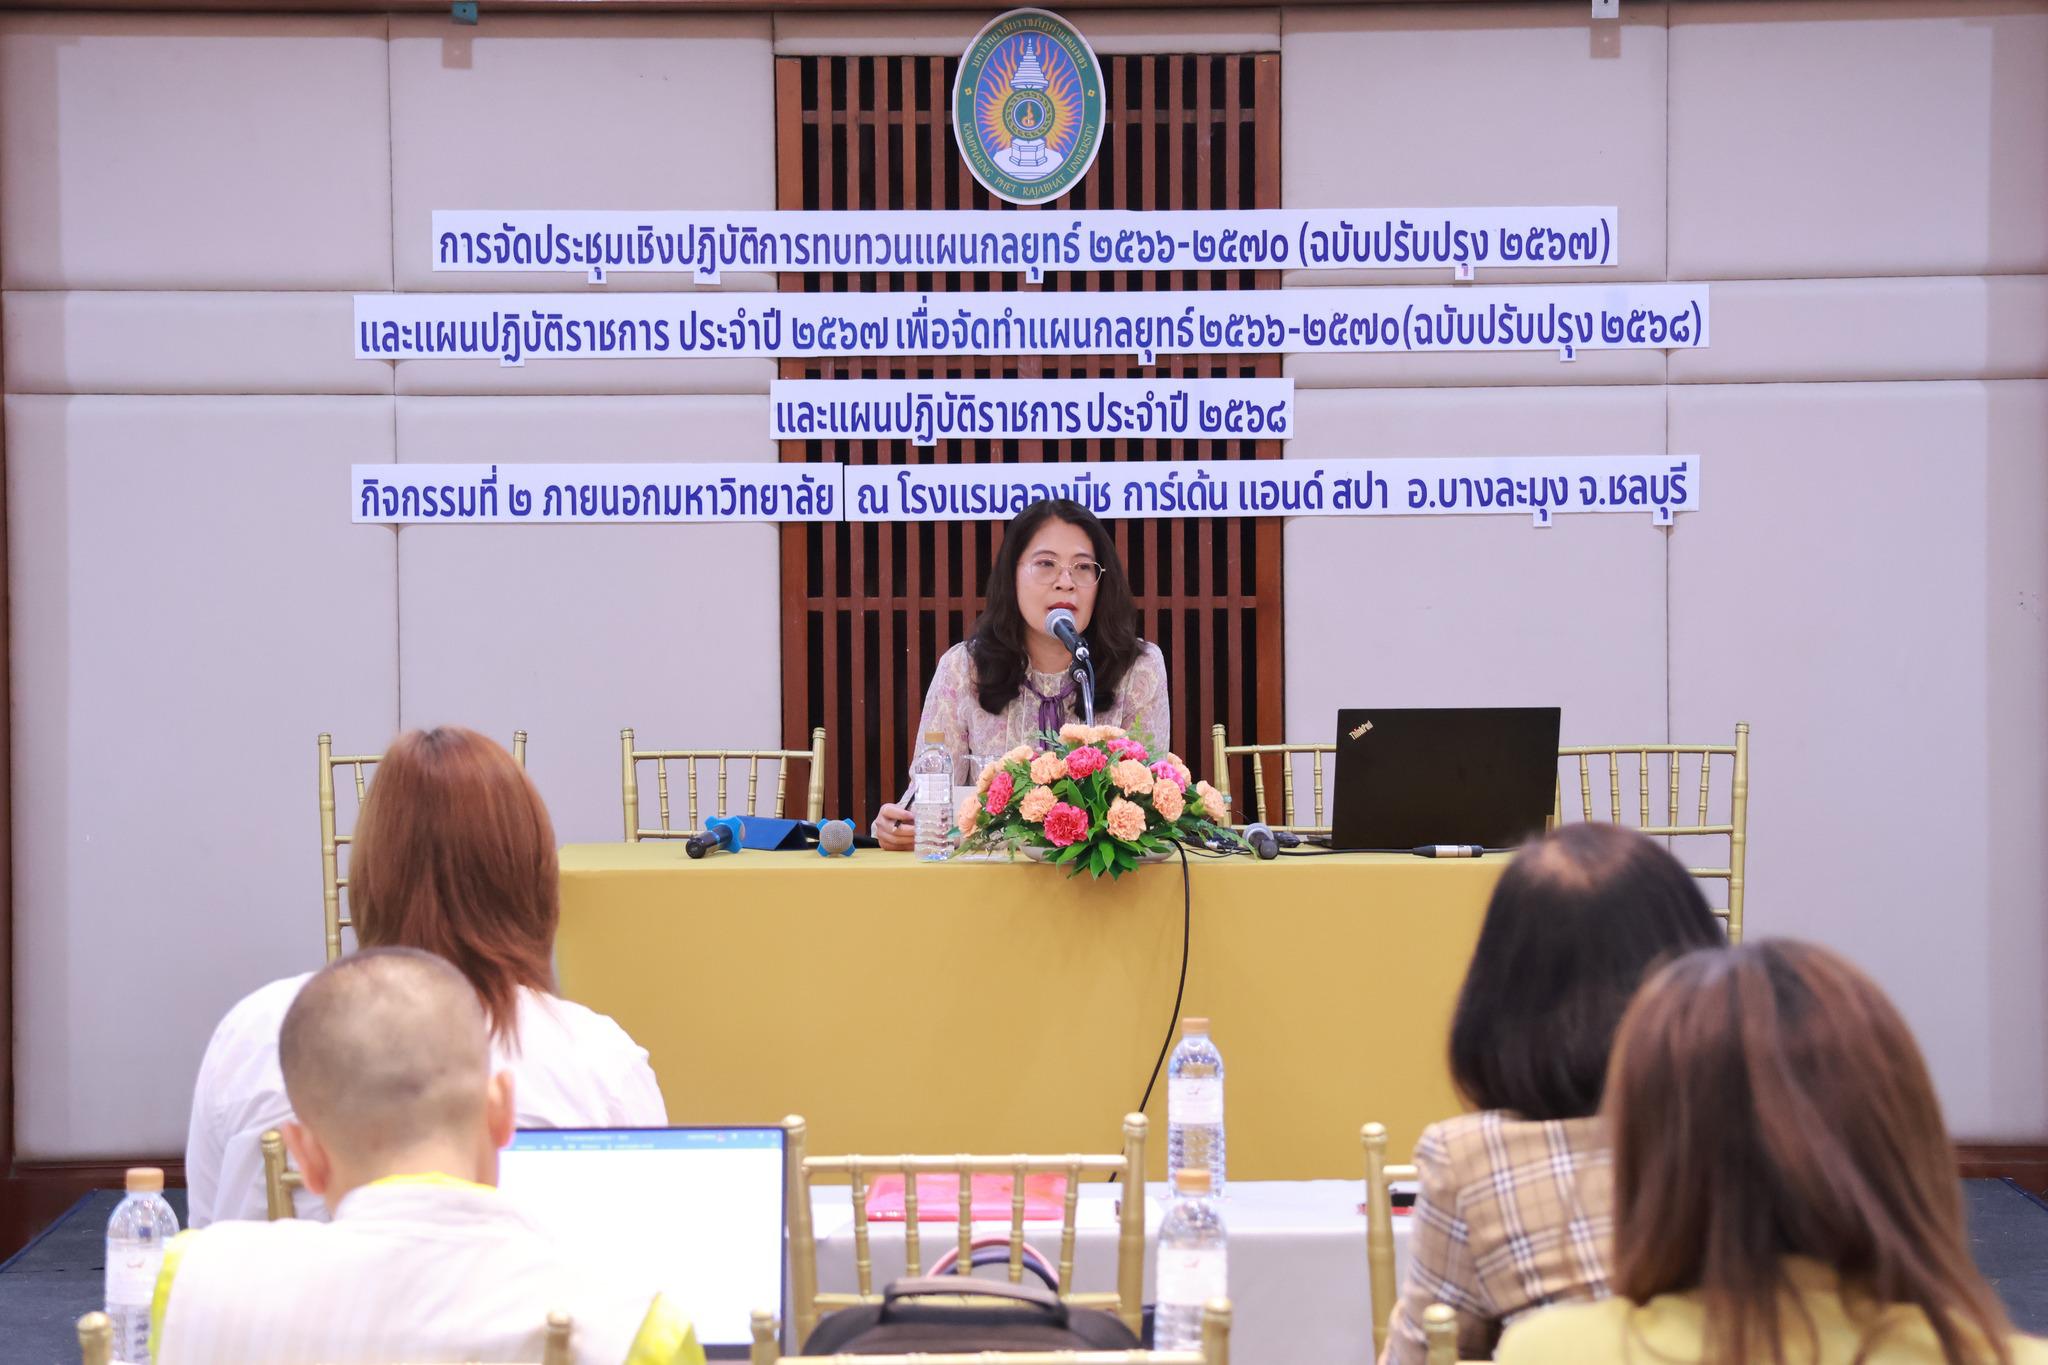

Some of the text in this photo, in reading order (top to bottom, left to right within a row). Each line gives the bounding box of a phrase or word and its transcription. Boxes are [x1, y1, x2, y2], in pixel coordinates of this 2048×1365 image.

[963, 122, 1096, 199] KAMPHAENG PHET RAJABHAT UNIVERSITY
[439, 217, 1610, 281] การจัดประชุมเชิงปฏิบัติการทบทวนแผนกลยุทธ์ ๒๕๖๖-๒๕๗๐ (ฉบับปรับปรุง ๒๕๖๗)
[361, 309, 671, 363] และแผนปฏิบัติราชการ
[679, 306, 782, 351] ประจำปี
[792, 315, 889, 350] ๒๕๖๗
[1601, 300, 1702, 347] ๒๕๖๘)
[1199, 398, 1287, 433] ๒๕๖๘
[361, 464, 498, 517] กิจกรรมที่
[508, 483, 533, 517] ๒
[542, 476, 834, 517] ภายนอกมหาวิทยาลัย
[857, 484, 889, 514] ณ
[1123, 468, 1228, 512] การ์เด้น
[1239, 469, 1325, 511] แอนด์
[1332, 470, 1388, 510] สปา
[1407, 476, 1569, 522] อ.บางละมุง
[1578, 461, 1688, 520] จ.ชลบุรี
